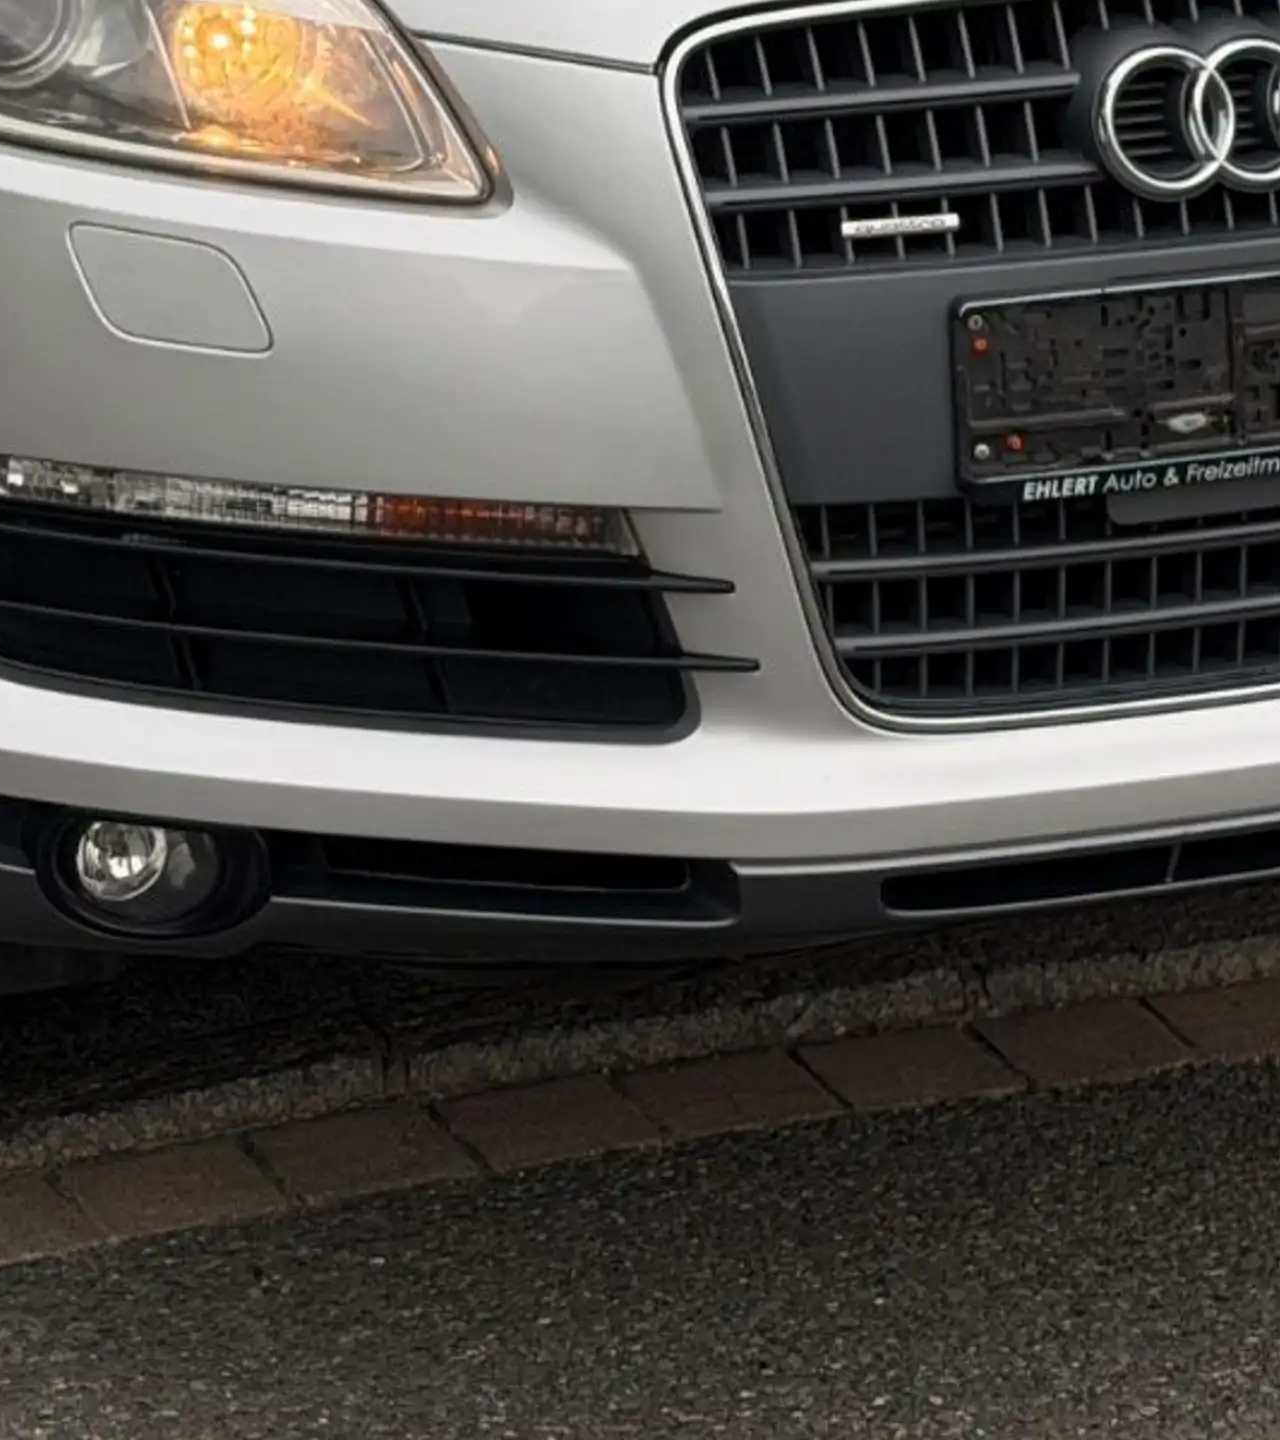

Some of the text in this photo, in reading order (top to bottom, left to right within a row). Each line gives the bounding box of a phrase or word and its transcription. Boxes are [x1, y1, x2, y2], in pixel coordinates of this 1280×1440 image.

[1022, 475, 1099, 502] EHLERT
[1102, 470, 1158, 493] Auto
[1162, 466, 1180, 487] &
